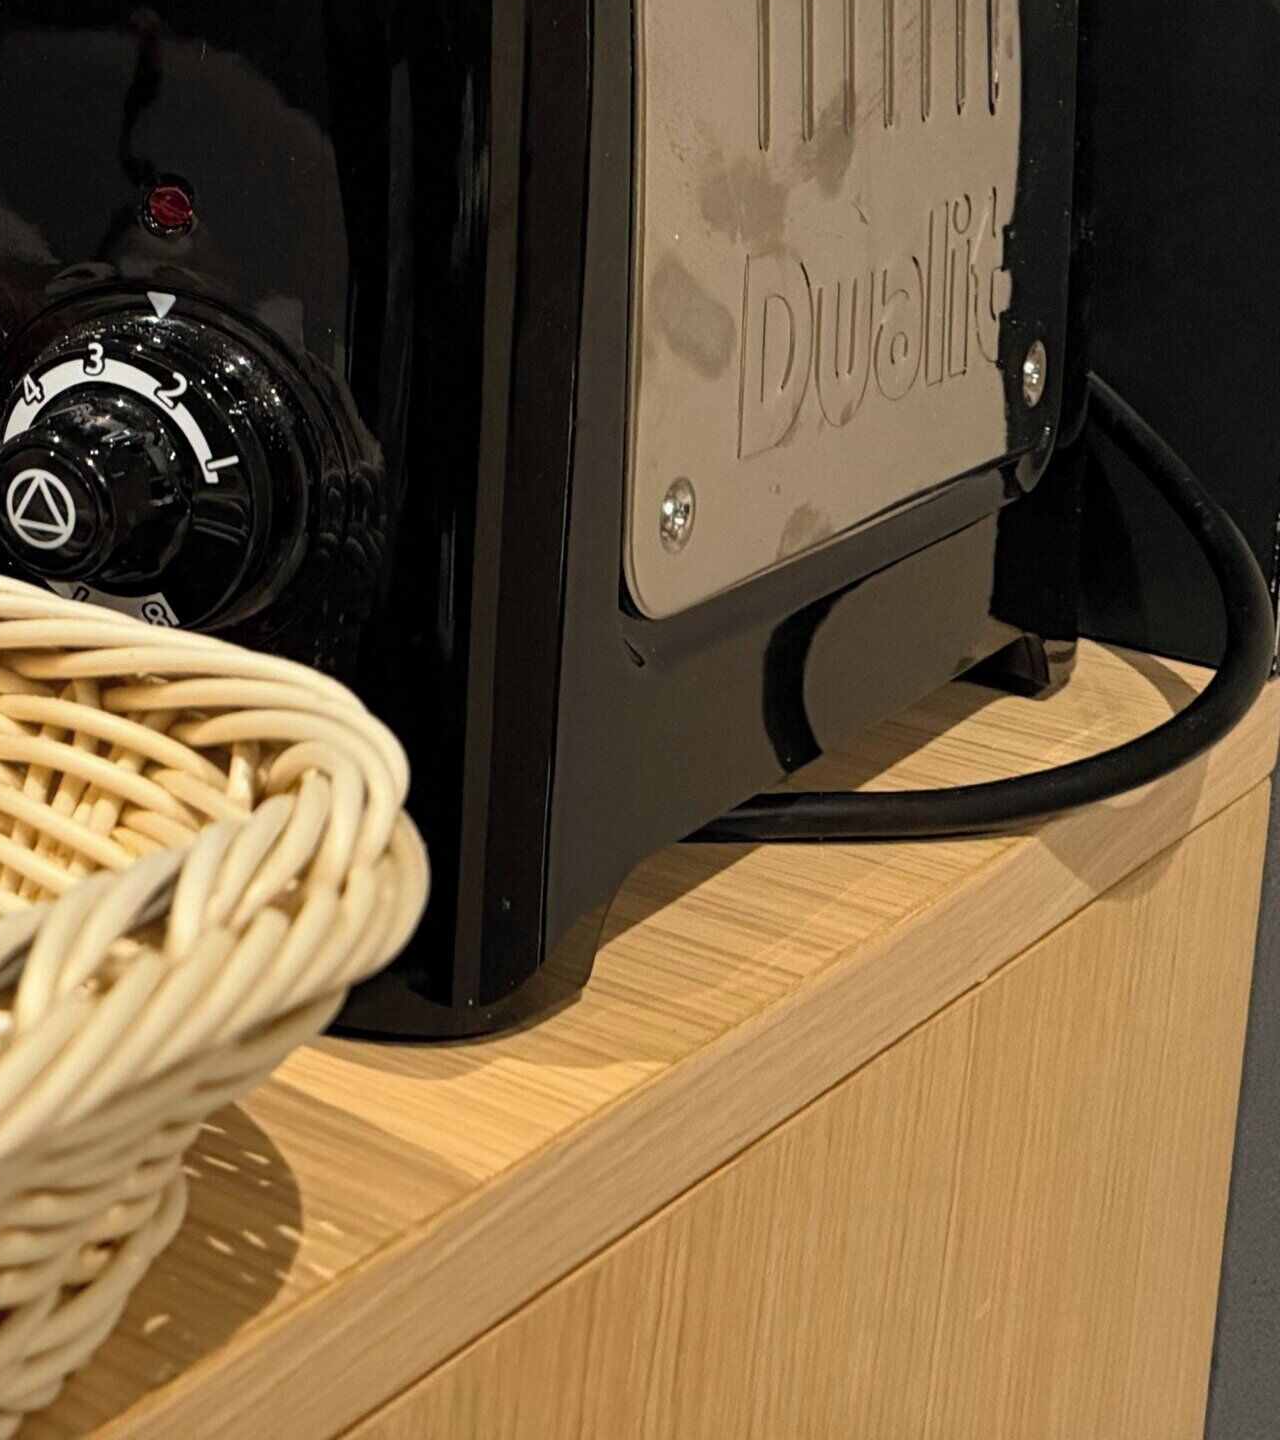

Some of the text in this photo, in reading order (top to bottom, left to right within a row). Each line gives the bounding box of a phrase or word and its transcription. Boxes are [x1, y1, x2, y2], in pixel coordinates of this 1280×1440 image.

[23, 374, 42, 403] 4
[83, 342, 104, 375] 3
[156, 372, 188, 408] 2
[737, 186, 1011, 460] Dualit
